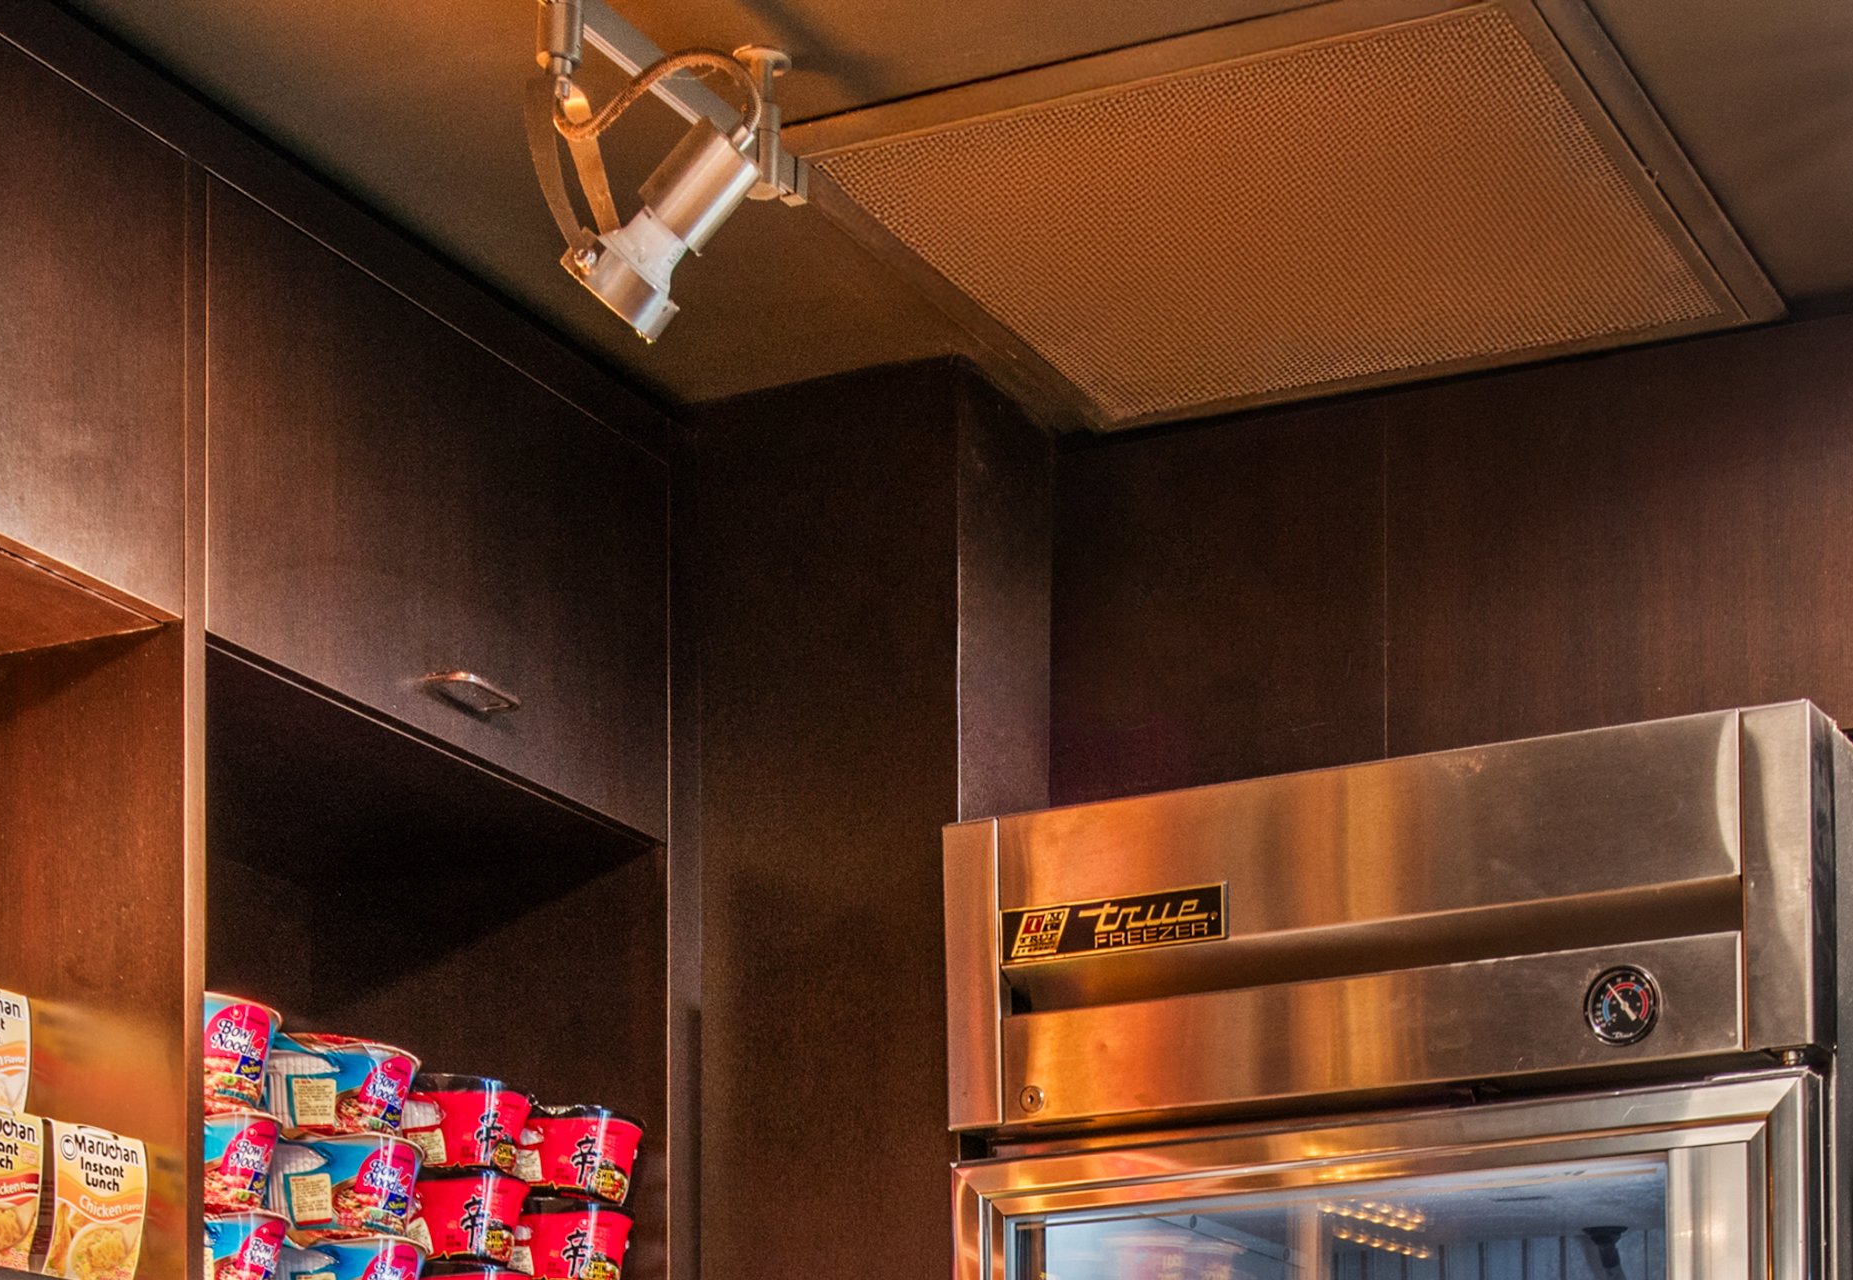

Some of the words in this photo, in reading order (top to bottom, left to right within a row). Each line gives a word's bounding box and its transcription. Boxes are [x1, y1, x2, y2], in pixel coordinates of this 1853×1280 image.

[1078, 899, 1209, 934] true
[1094, 922, 1208, 949] FREEZER
[218, 1020, 255, 1045] Bowl
